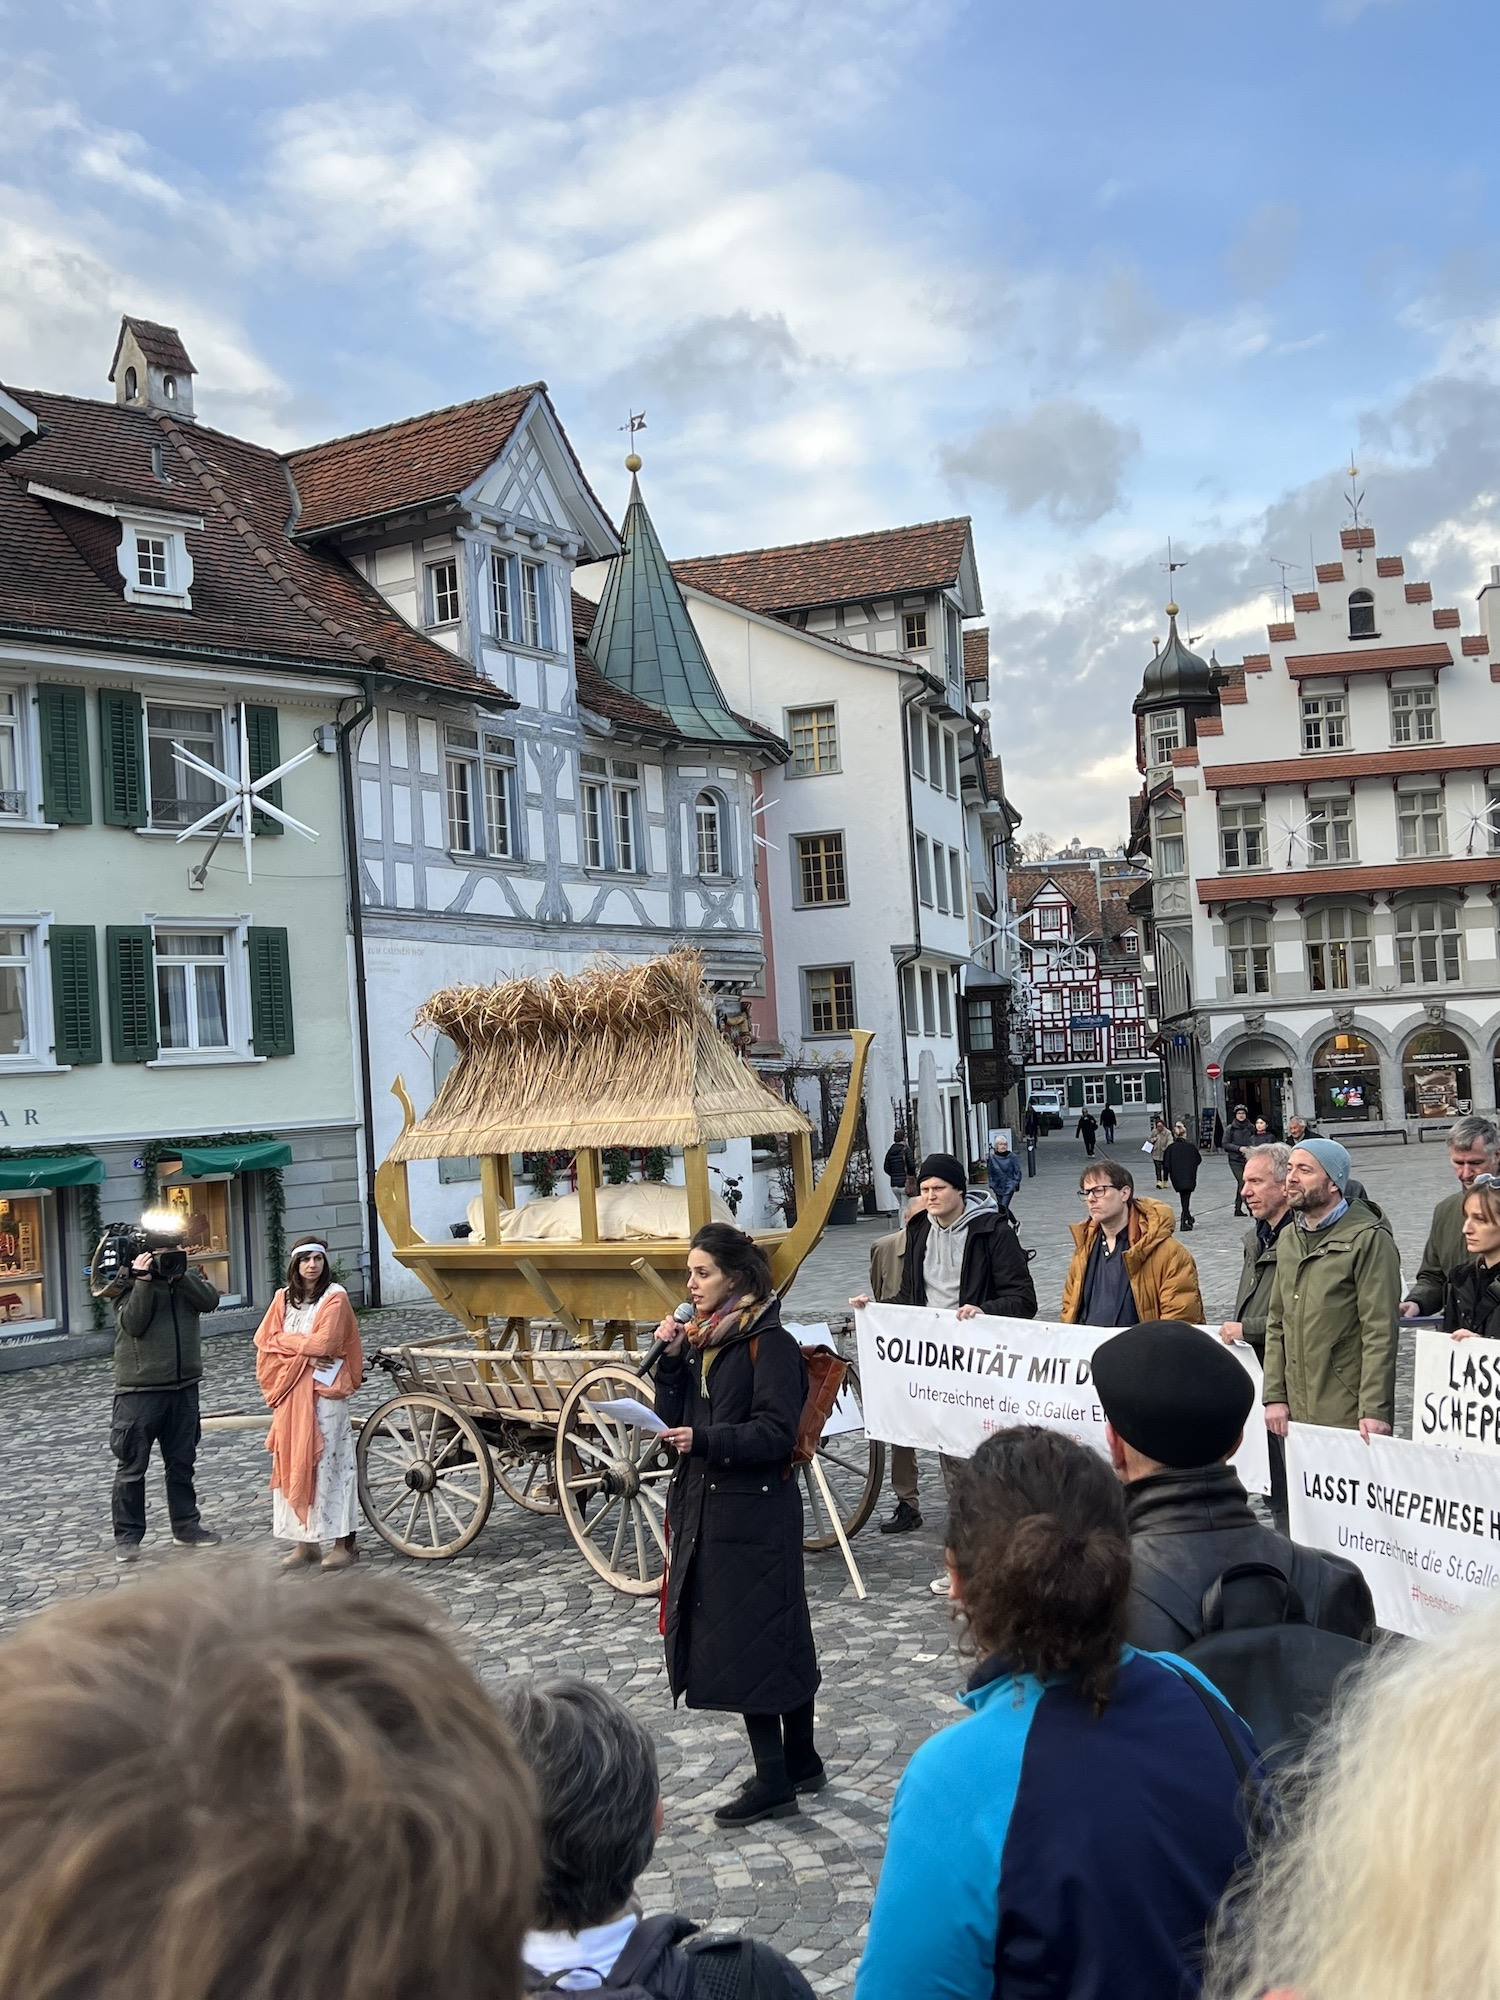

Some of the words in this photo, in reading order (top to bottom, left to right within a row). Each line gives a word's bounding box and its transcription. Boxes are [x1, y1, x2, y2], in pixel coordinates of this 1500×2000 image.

[876, 1336, 1023, 1379] SOLIDARITÄT
[1027, 1356, 1071, 1385] MIT
[1076, 1359, 1095, 1386] D
[909, 1382, 995, 1411] Unterzeichnet
[999, 1396, 1019, 1414] die
[1025, 1400, 1086, 1421] St.Galler
[1303, 1471, 1360, 1505] LASST
[1366, 1482, 1485, 1537] SCHEPENESE
[1338, 1525, 1418, 1568] Unterzeichnet
[1421, 1550, 1442, 1574] die
